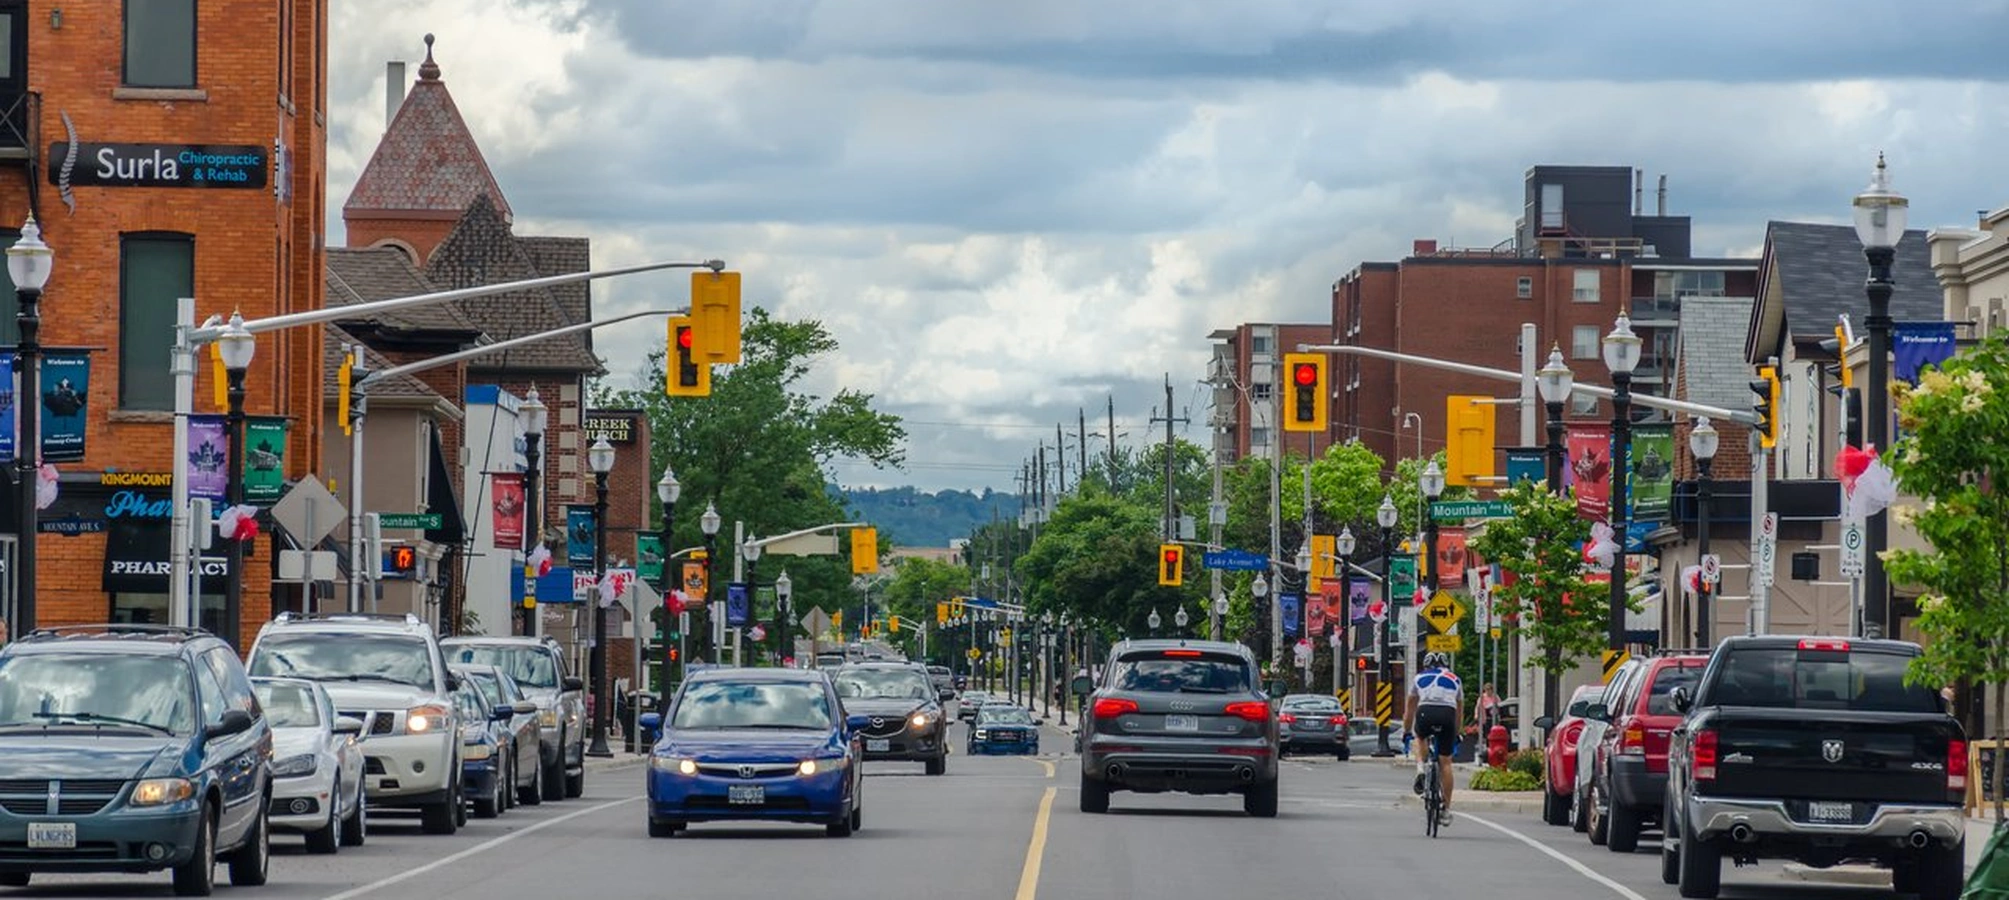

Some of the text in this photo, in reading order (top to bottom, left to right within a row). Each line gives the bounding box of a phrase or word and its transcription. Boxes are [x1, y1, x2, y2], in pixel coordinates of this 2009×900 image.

[97, 147, 179, 180] Surla
[178, 151, 260, 167] Chiropractic
[192, 168, 247, 181] & Rehab
[1902, 335, 1938, 343] Welcome
[102, 473, 172, 486] KINGMOUNT
[1434, 504, 1488, 516] Mountain
[1503, 503, 1513, 515] N
[43, 522, 78, 532] MOUNTAIN
[379, 517, 418, 527] ountain
[429, 516, 439, 527] S
[110, 560, 228, 576] PHARACY
[1208, 557, 1226, 566] Lake
[1227, 558, 1253, 566] Avenue
